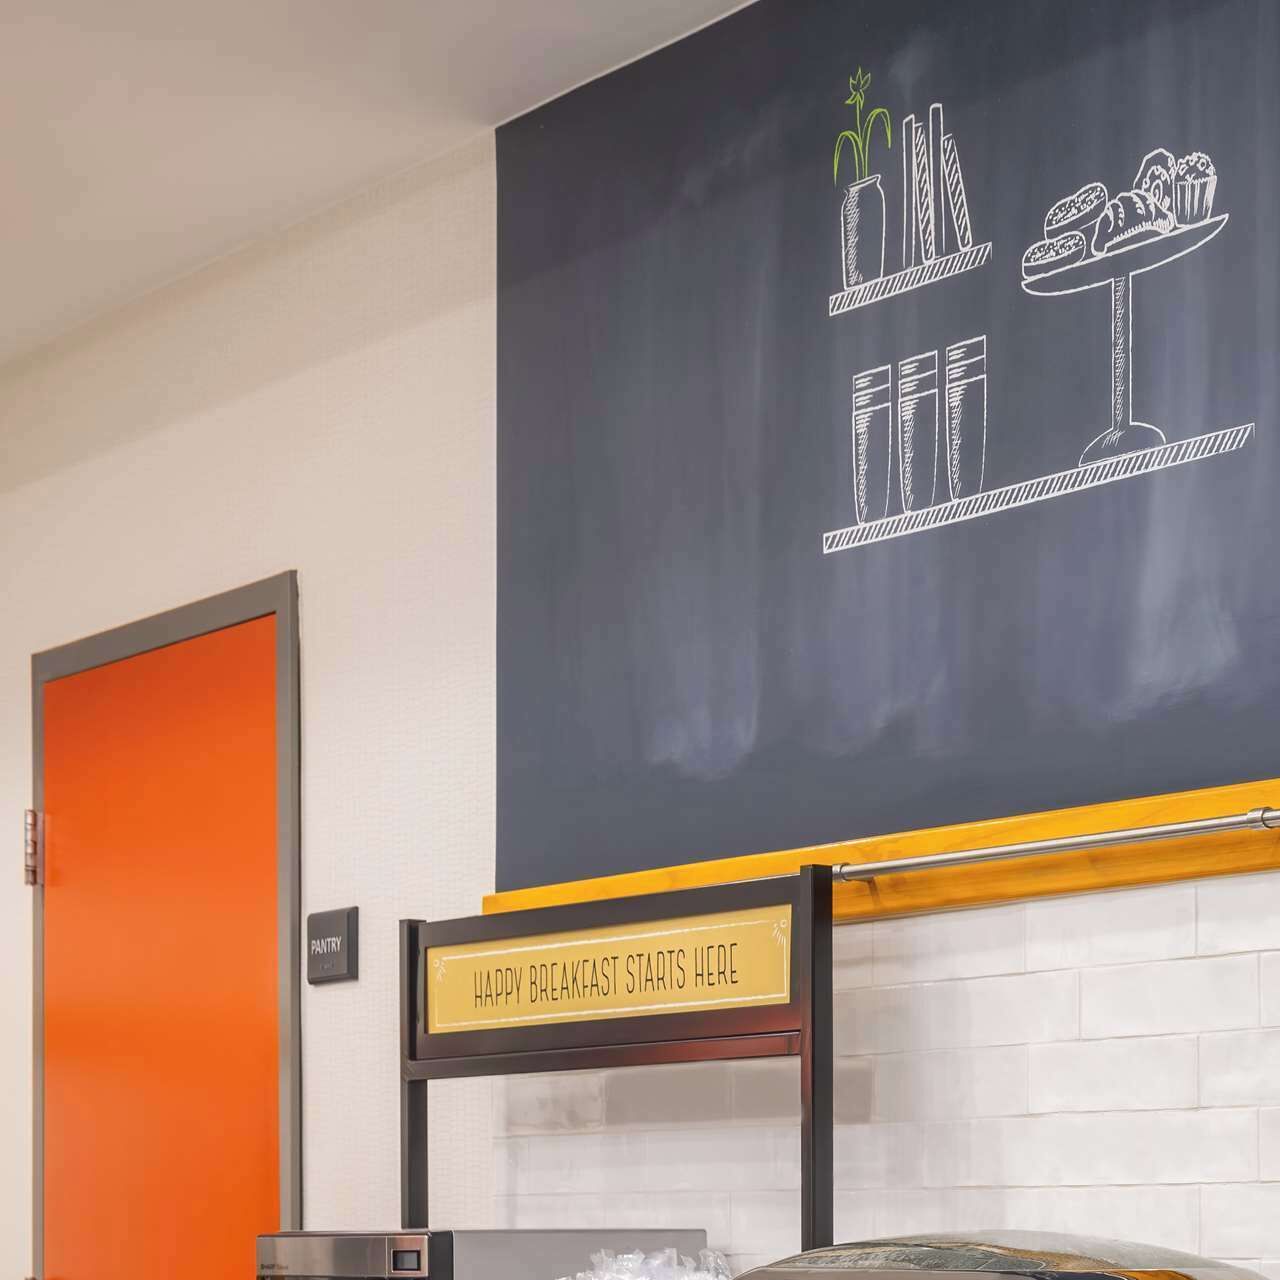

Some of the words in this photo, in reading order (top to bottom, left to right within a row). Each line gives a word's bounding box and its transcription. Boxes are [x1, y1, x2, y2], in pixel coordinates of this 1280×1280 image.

[311, 936, 342, 955] PANTRY
[474, 966, 523, 1009] HAPPY
[529, 956, 619, 1003] BREAKFAST
[626, 949, 686, 994] STARTS
[694, 942, 739, 988] HERE
